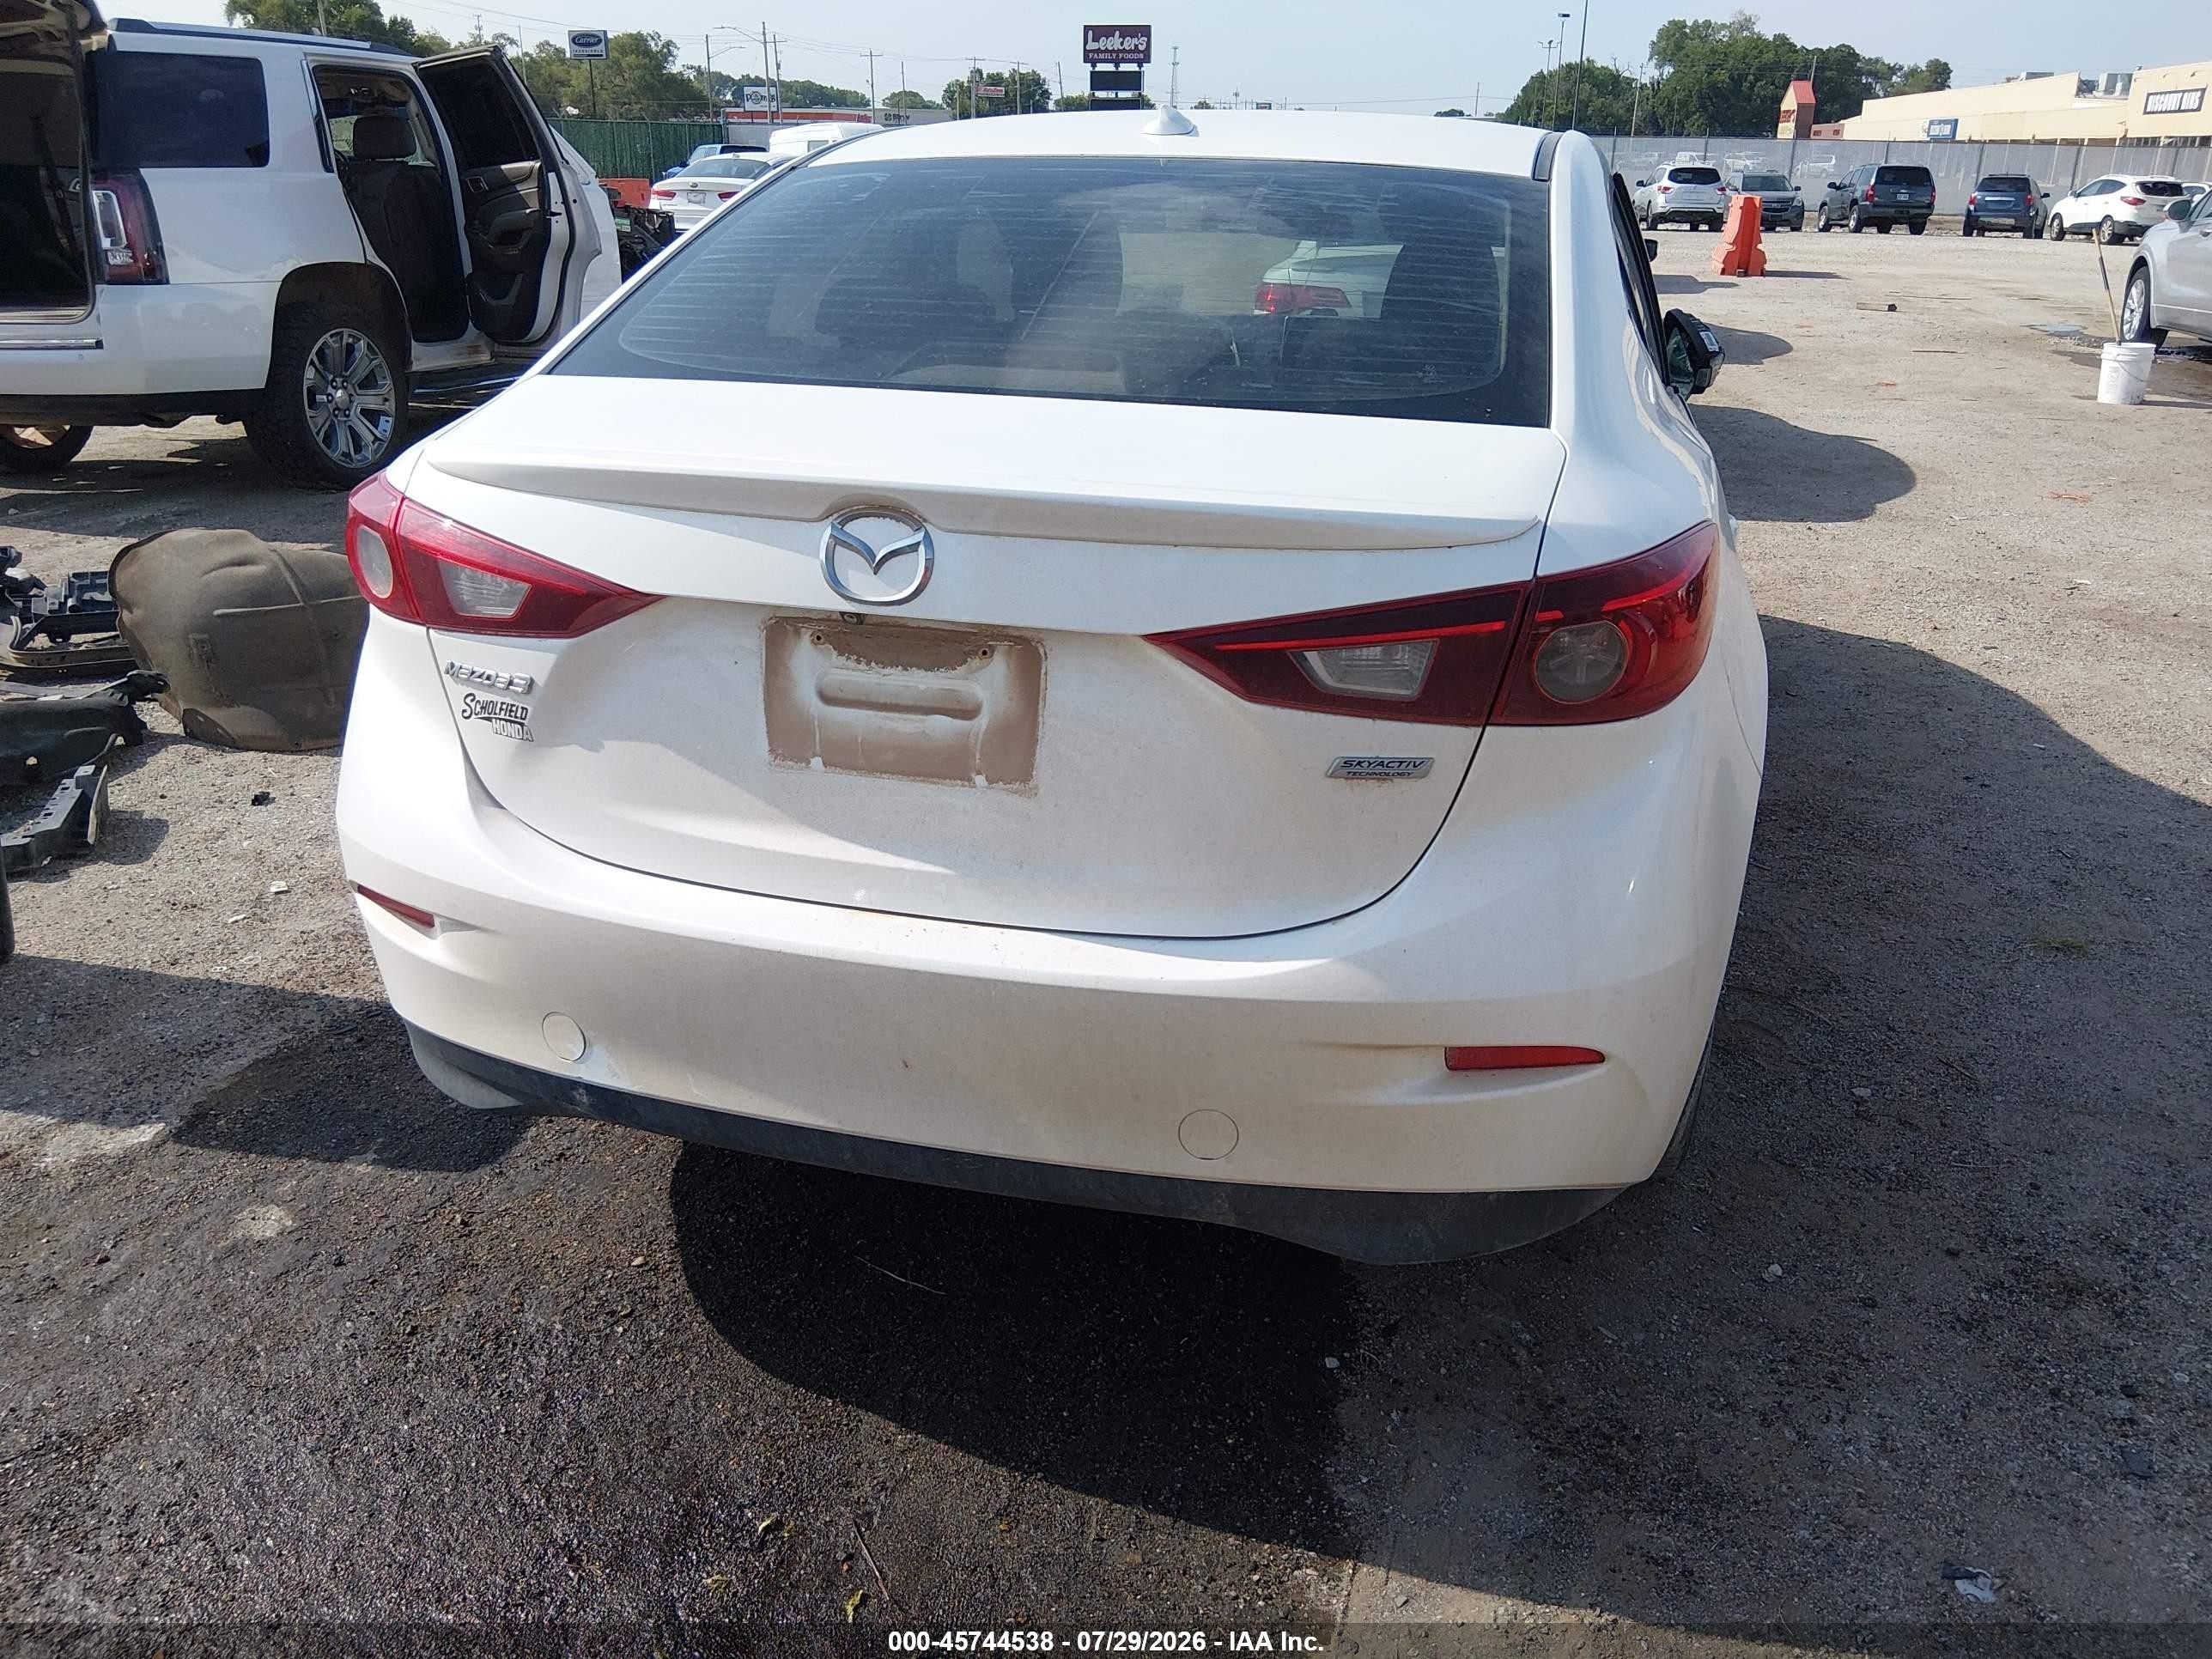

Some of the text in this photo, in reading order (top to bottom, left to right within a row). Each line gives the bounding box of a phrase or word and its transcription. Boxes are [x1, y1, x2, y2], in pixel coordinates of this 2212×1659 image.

[1085, 30, 1148, 51] Leeker's
[2146, 91, 2202, 112] DISCOUNT BINS
[491, 719, 534, 742] HONDA
[1340, 759, 1426, 769] SKYACTIV
